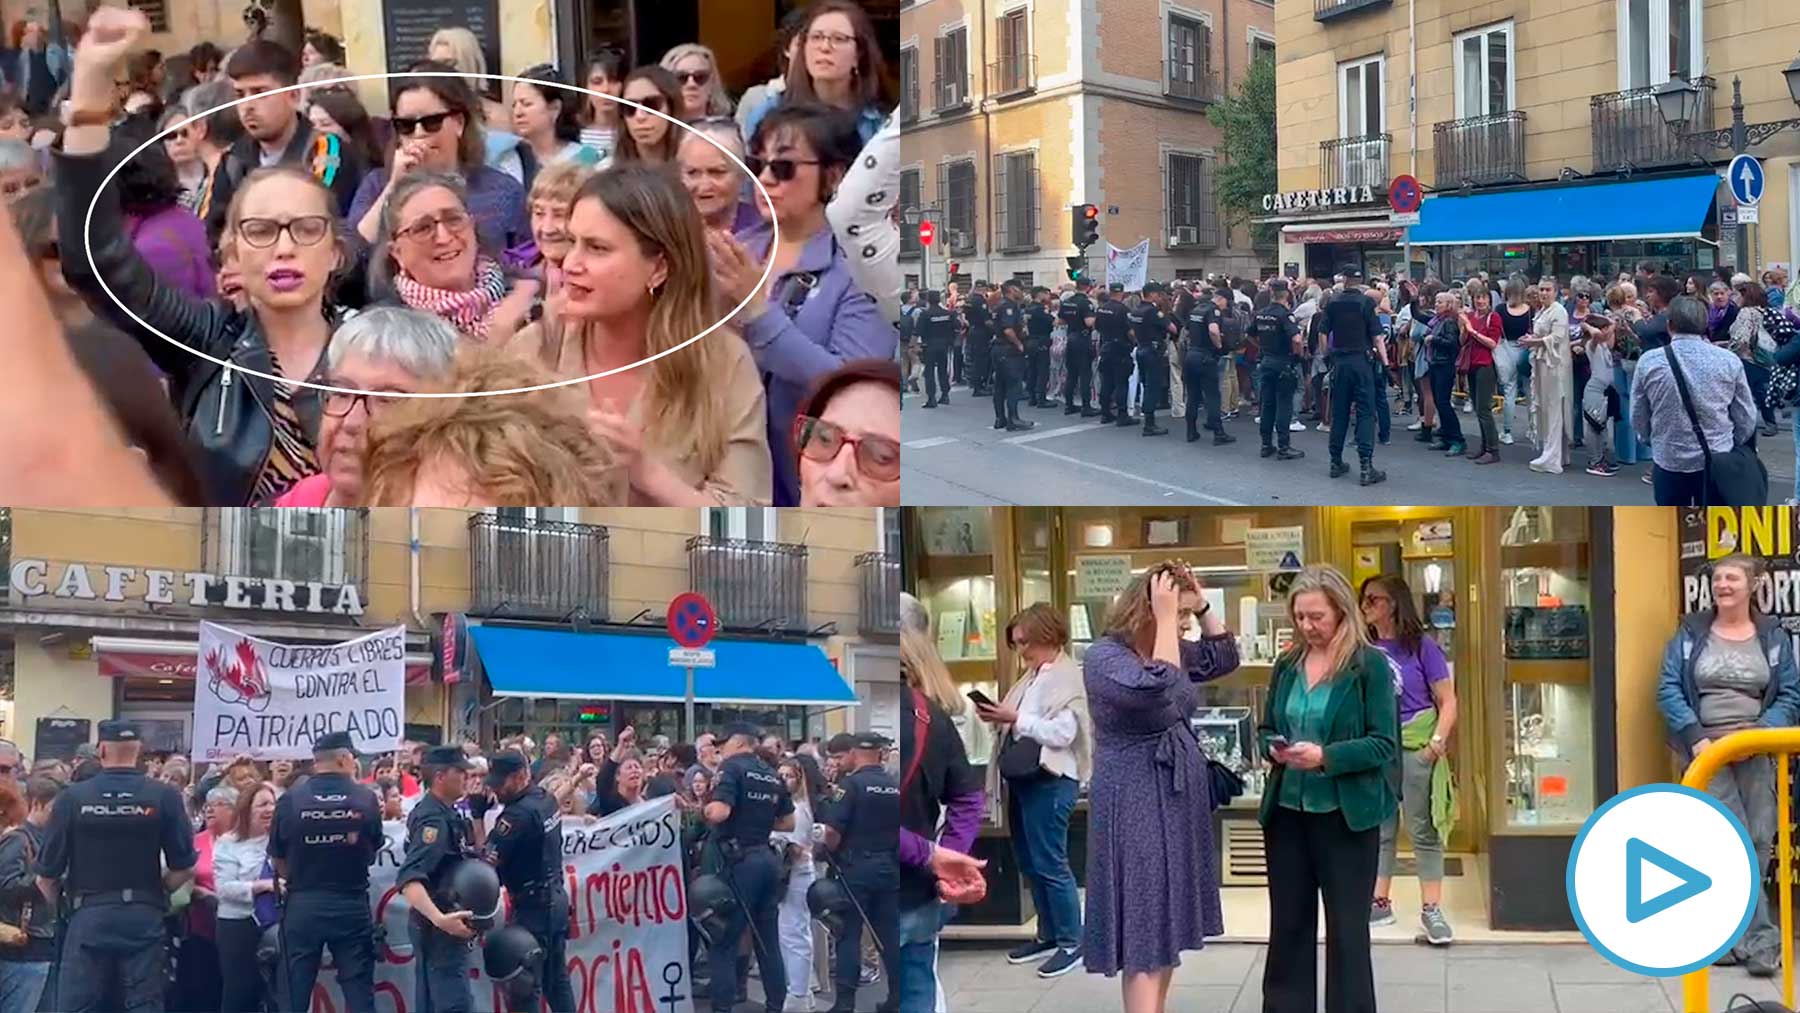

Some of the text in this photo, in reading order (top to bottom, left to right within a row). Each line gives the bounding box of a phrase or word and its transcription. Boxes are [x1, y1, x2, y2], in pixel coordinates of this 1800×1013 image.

[1262, 185, 1375, 211] CAFETERIA
[1706, 506, 1791, 559] DNI
[10, 559, 365, 615] CAFETERIA
[269, 646, 341, 670] CUERPOS
[295, 669, 387, 699] CONTRA EL
[746, 771, 781, 785] POLICIA
[80, 805, 147, 816] POLICIA
[300, 810, 353, 820] POLICIA
[564, 811, 676, 854] ERECHOS
